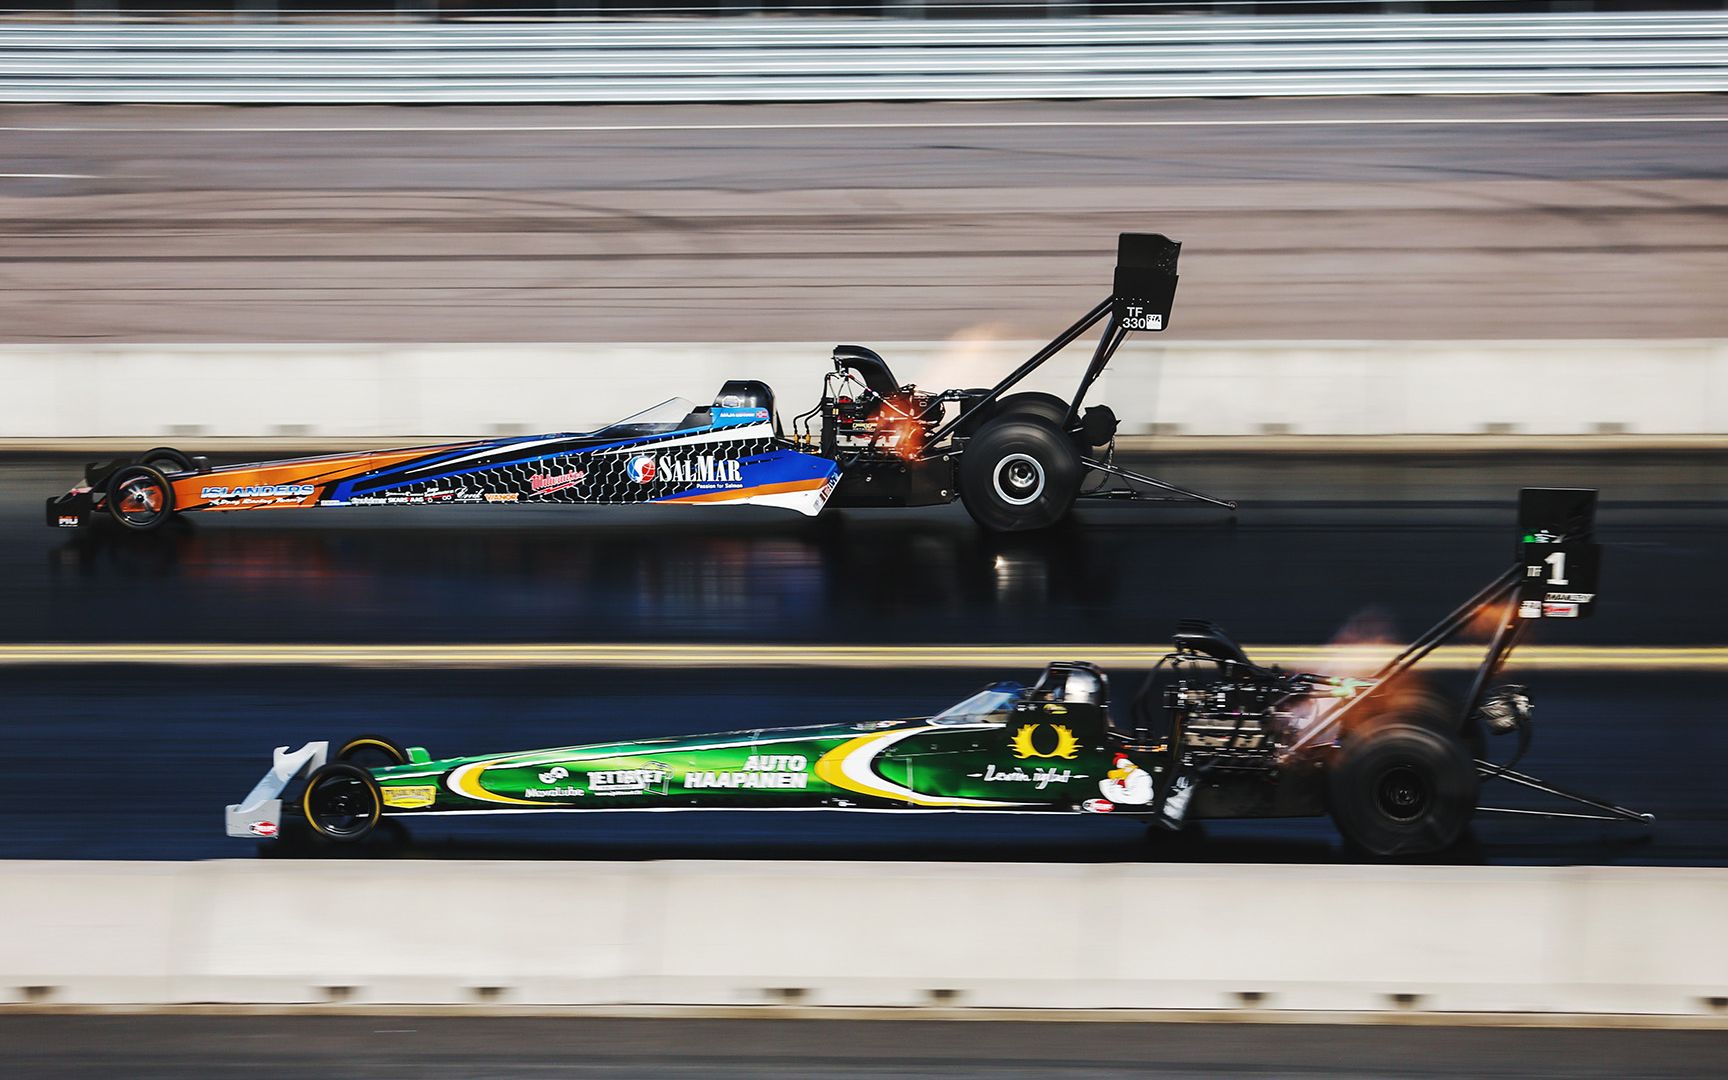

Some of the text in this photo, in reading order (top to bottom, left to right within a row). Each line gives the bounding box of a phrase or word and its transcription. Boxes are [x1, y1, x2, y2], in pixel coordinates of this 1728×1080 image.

[1126, 306, 1143, 317] TF
[1122, 317, 1146, 329] 330
[200, 484, 315, 499] ISLANDERS
[1527, 565, 1542, 577] TF
[1544, 552, 1569, 586] 1
[742, 755, 808, 772] AUTO
[684, 772, 809, 789] HAAPANEN
